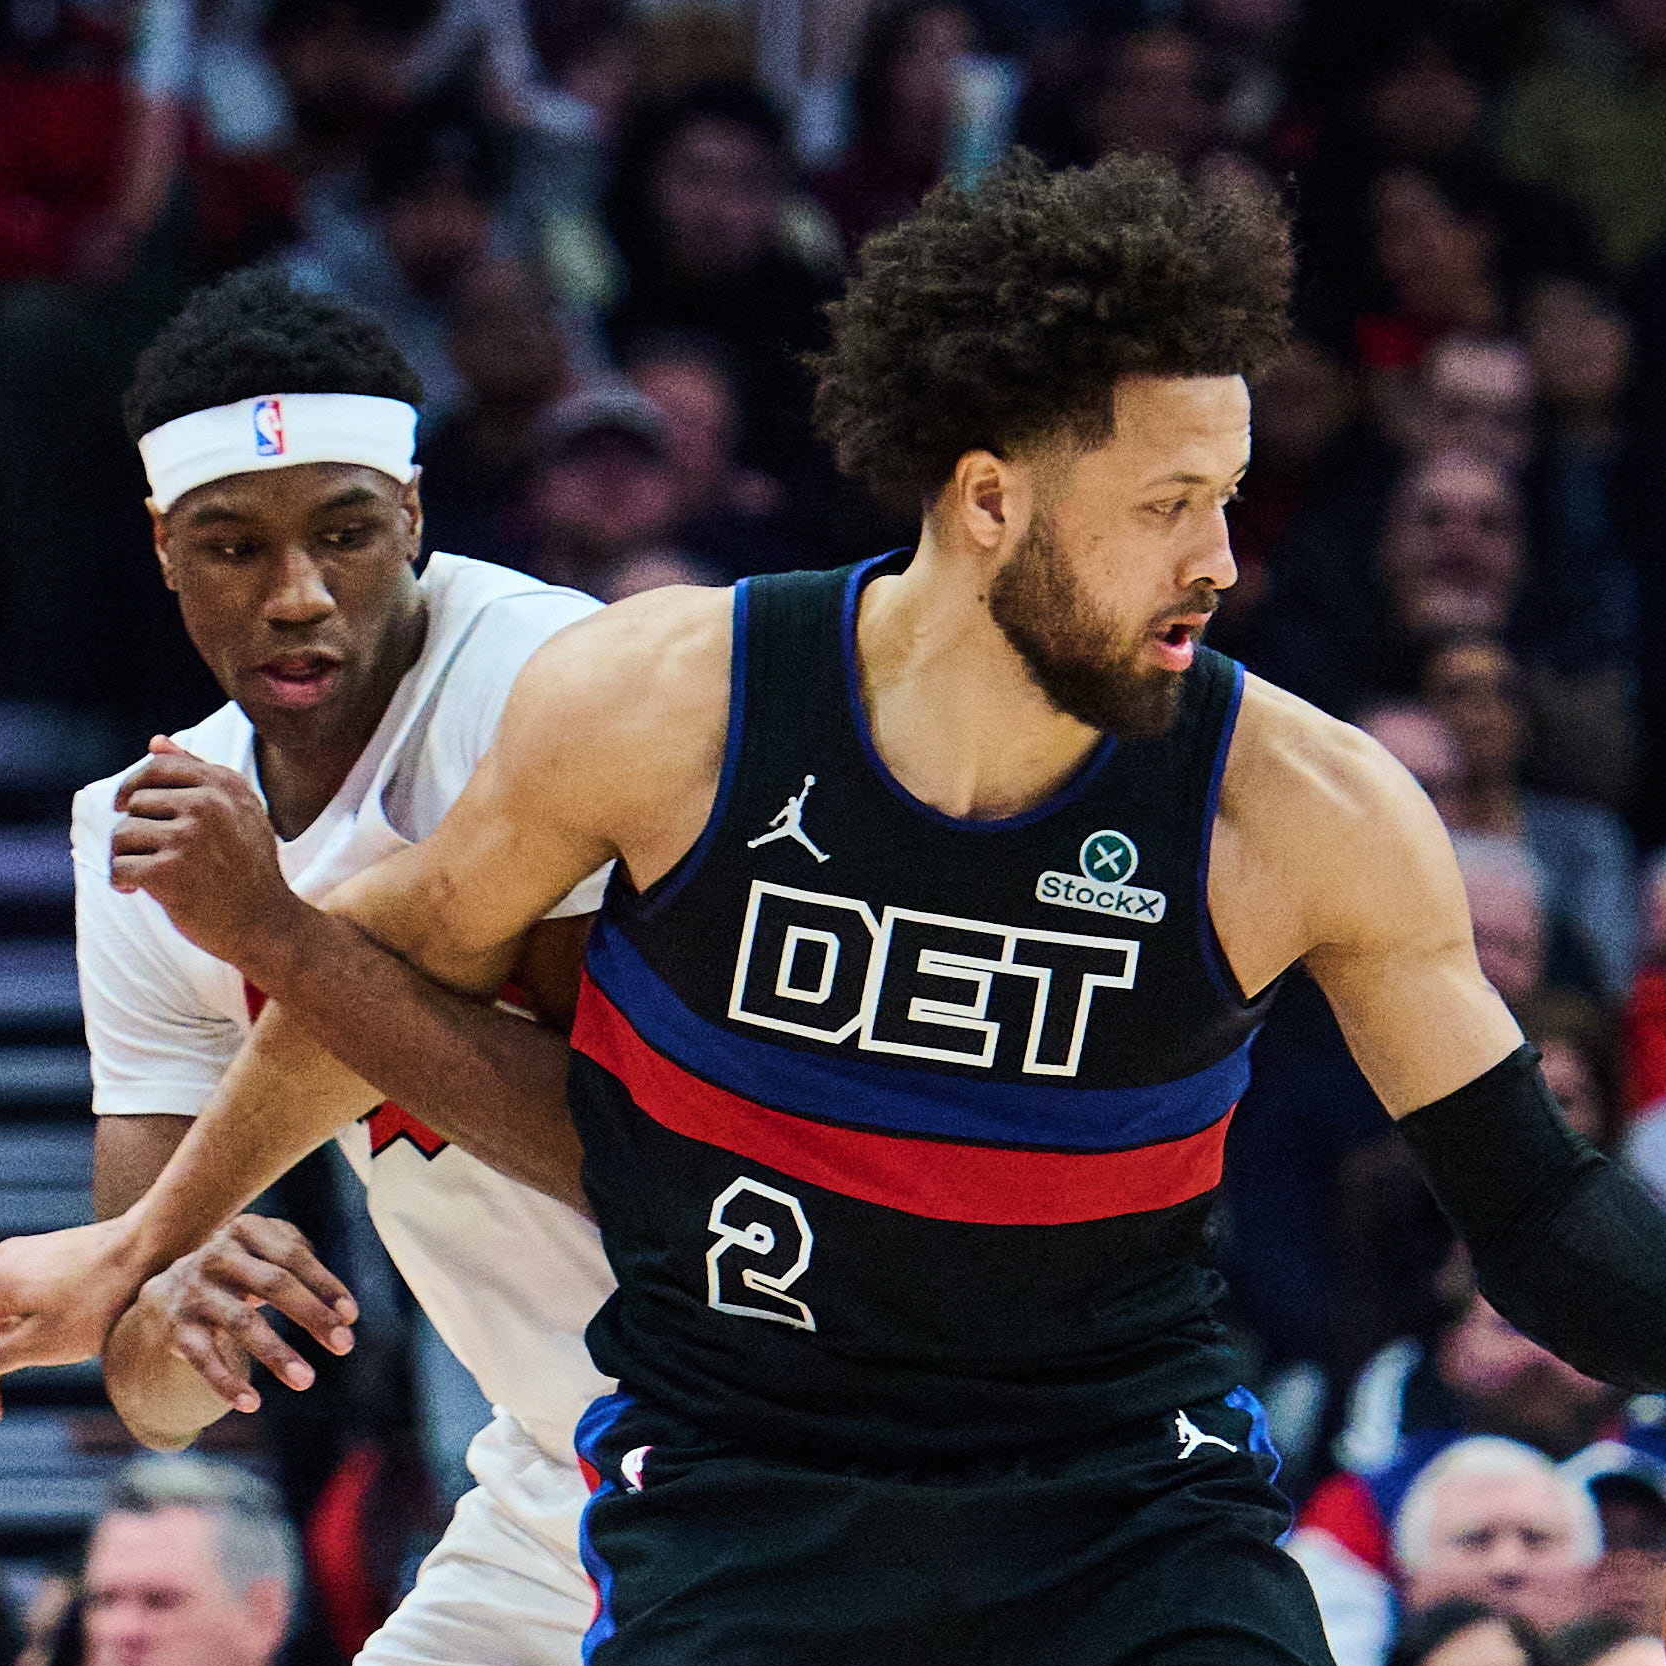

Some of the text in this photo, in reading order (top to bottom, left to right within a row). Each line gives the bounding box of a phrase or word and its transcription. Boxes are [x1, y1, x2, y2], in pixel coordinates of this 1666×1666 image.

[1041, 876, 1160, 918] StockX
[728, 879, 1140, 1077] DET
[707, 1176, 817, 1332] 2
